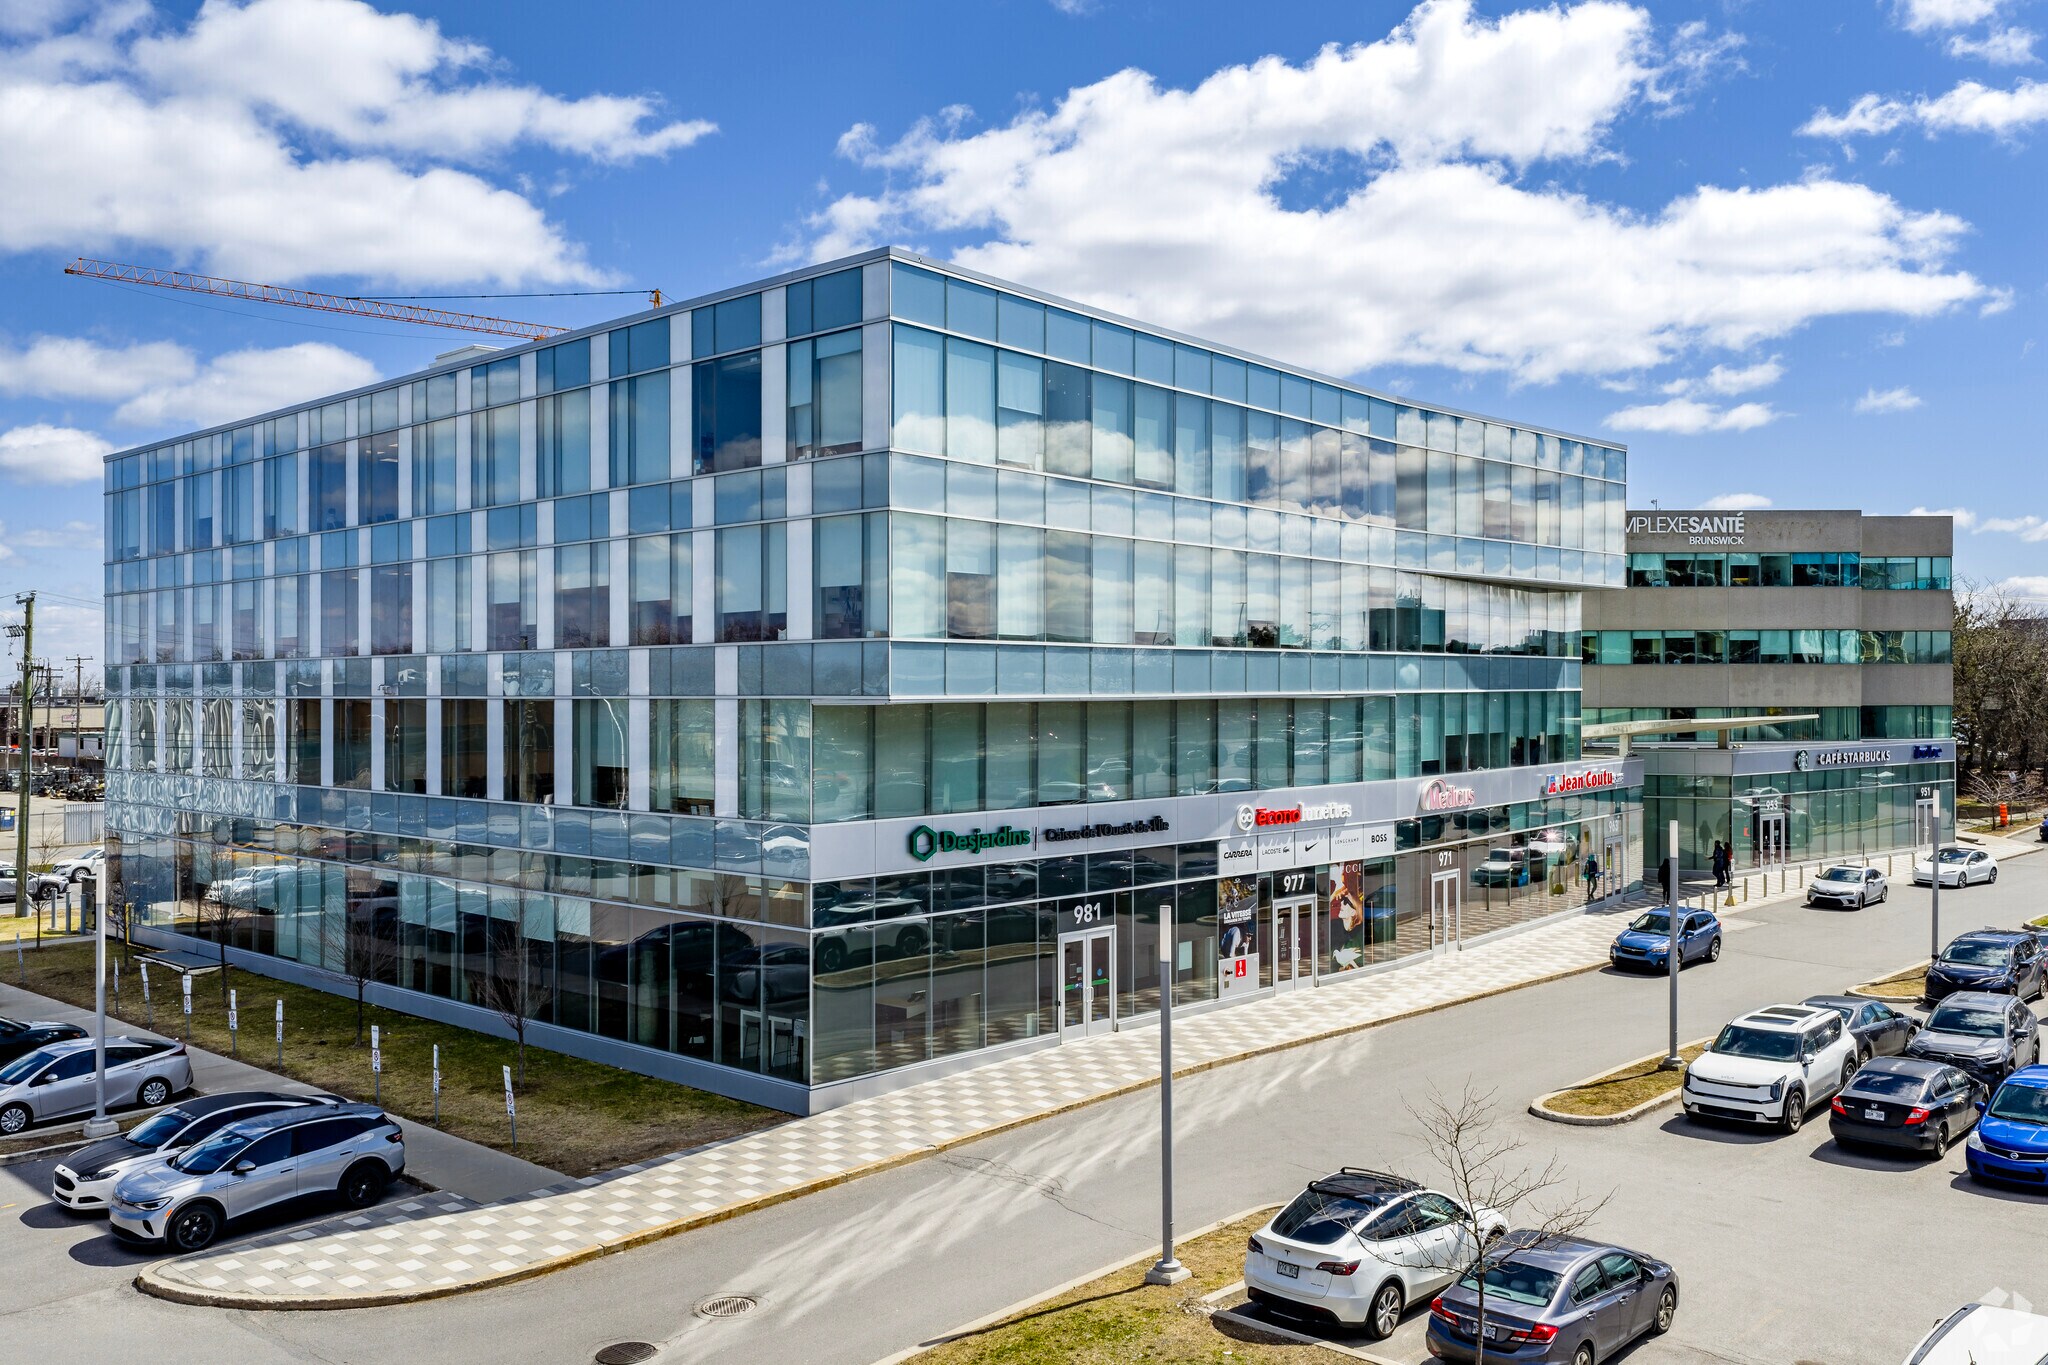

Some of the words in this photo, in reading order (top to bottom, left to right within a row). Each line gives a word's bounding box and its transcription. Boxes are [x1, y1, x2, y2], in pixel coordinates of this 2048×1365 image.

[1689, 536, 1744, 545] BRUNSWICK
[1843, 750, 1891, 764] STARBUCKS
[1559, 774, 1584, 792] Jean
[1586, 770, 1613, 788] Coutu
[1920, 786, 1931, 797] 951
[1765, 800, 1778, 811] 953
[940, 826, 1031, 854] Desjardins
[1045, 828, 1081, 842] Caisse
[1081, 825, 1097, 839] de
[1370, 833, 1388, 843] BOSS
[1223, 849, 1253, 859] CARRERA
[1261, 848, 1282, 856] LACOSTE
[1438, 851, 1452, 867] 971
[1283, 874, 1305, 893] 977
[1073, 902, 1101, 924] 981
